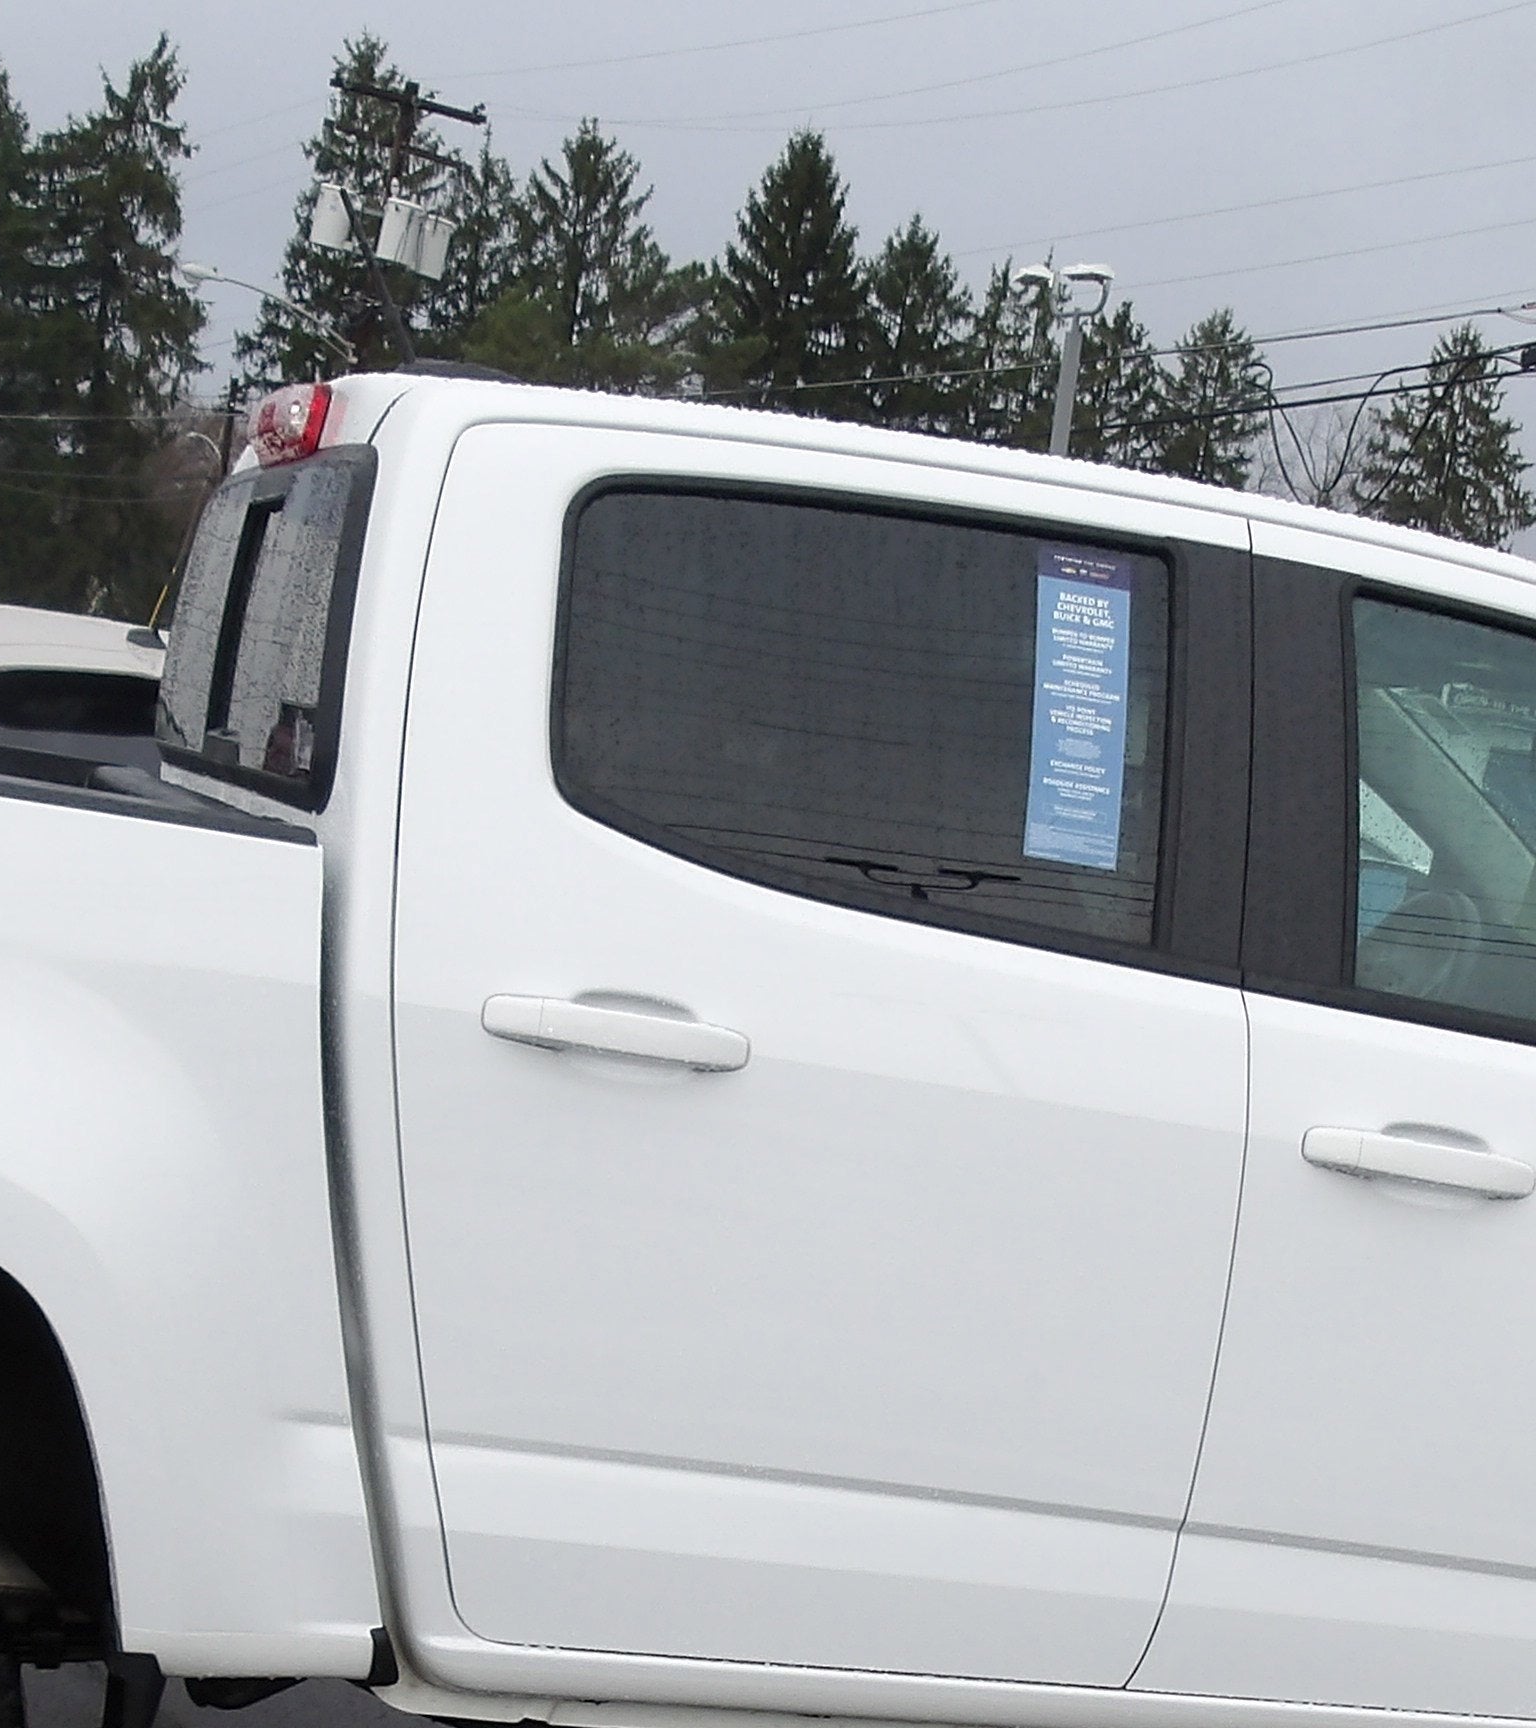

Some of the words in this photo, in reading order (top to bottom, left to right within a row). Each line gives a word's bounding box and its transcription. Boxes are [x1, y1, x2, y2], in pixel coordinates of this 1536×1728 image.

[1059, 592, 1095, 606] BACKED
[1097, 600, 1109, 609] BY
[1053, 611, 1081, 623] BUICK
[1092, 618, 1115, 630] GMC
